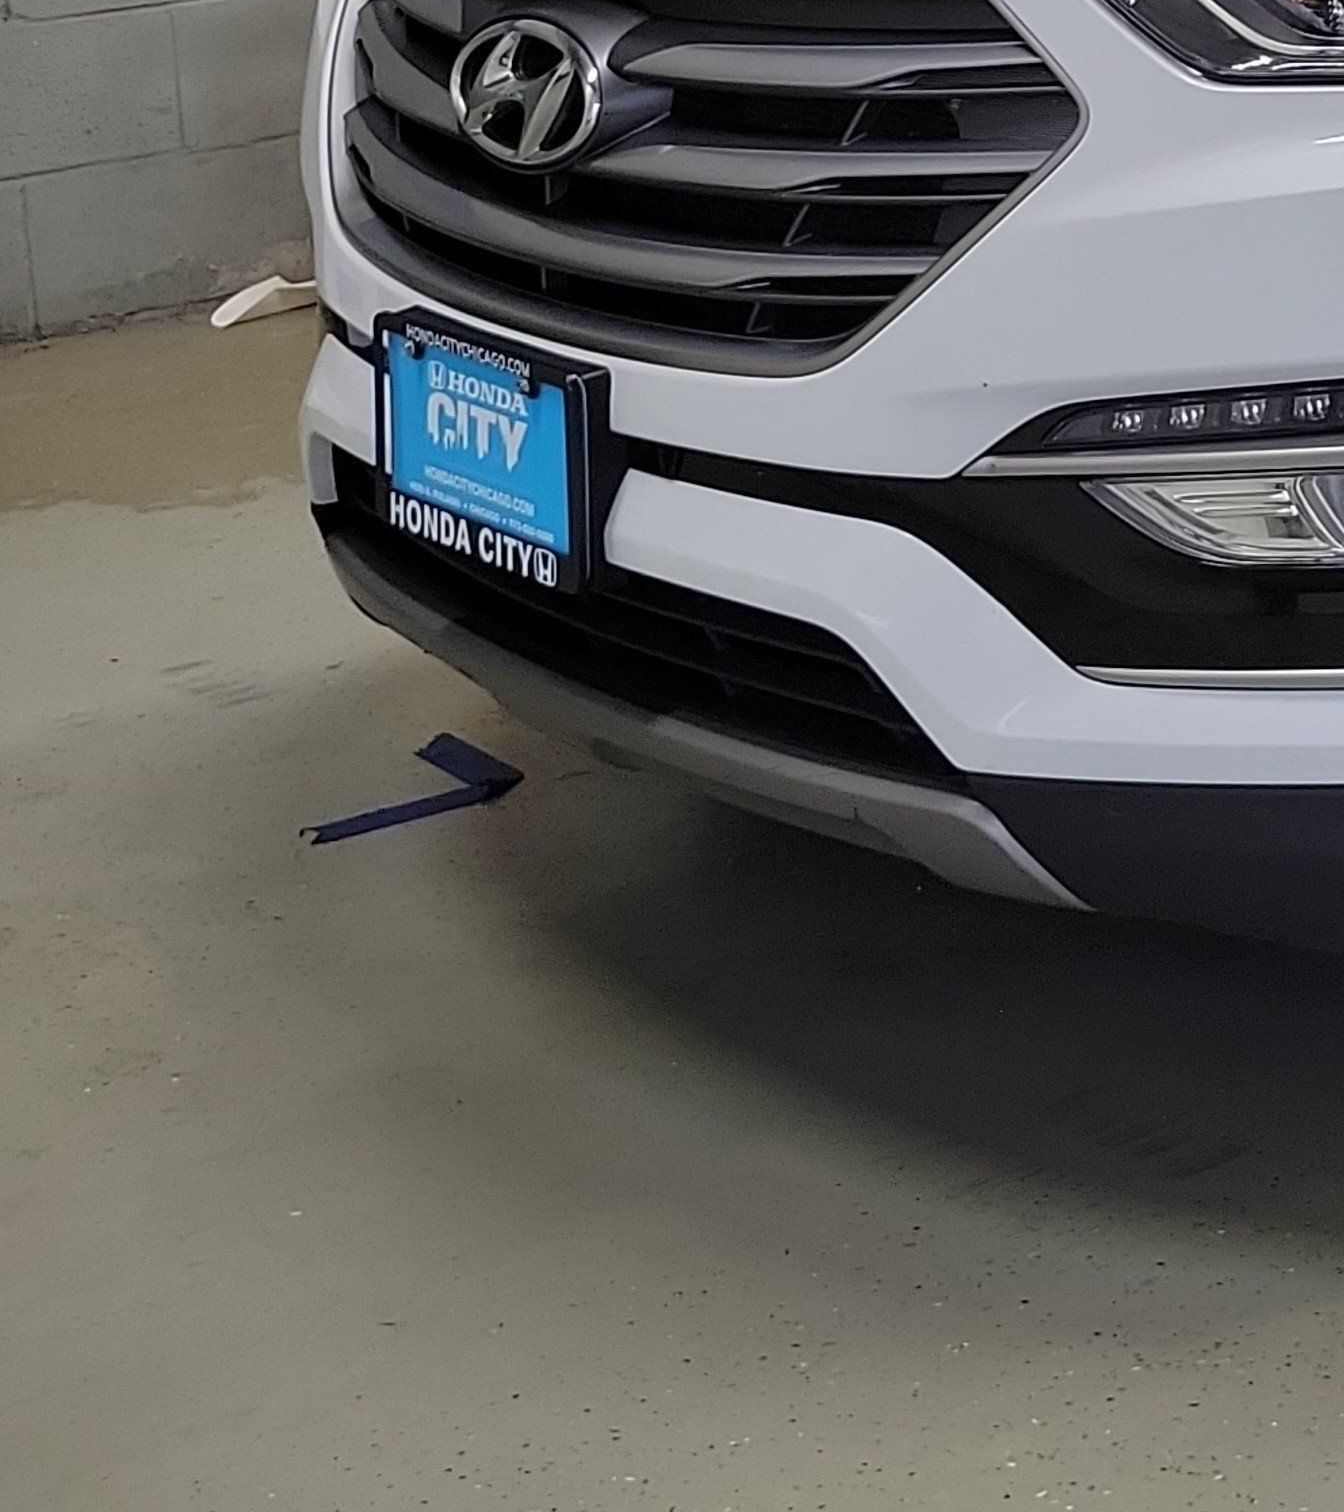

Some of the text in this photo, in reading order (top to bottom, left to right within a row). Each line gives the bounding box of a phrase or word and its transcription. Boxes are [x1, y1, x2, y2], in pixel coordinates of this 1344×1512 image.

[405, 323, 531, 378] HONDACITYCHICAGO.COM
[450, 370, 529, 416] HONDA
[427, 391, 529, 473] CITY
[389, 491, 471, 555] HONDA
[478, 526, 532, 577] CITY
